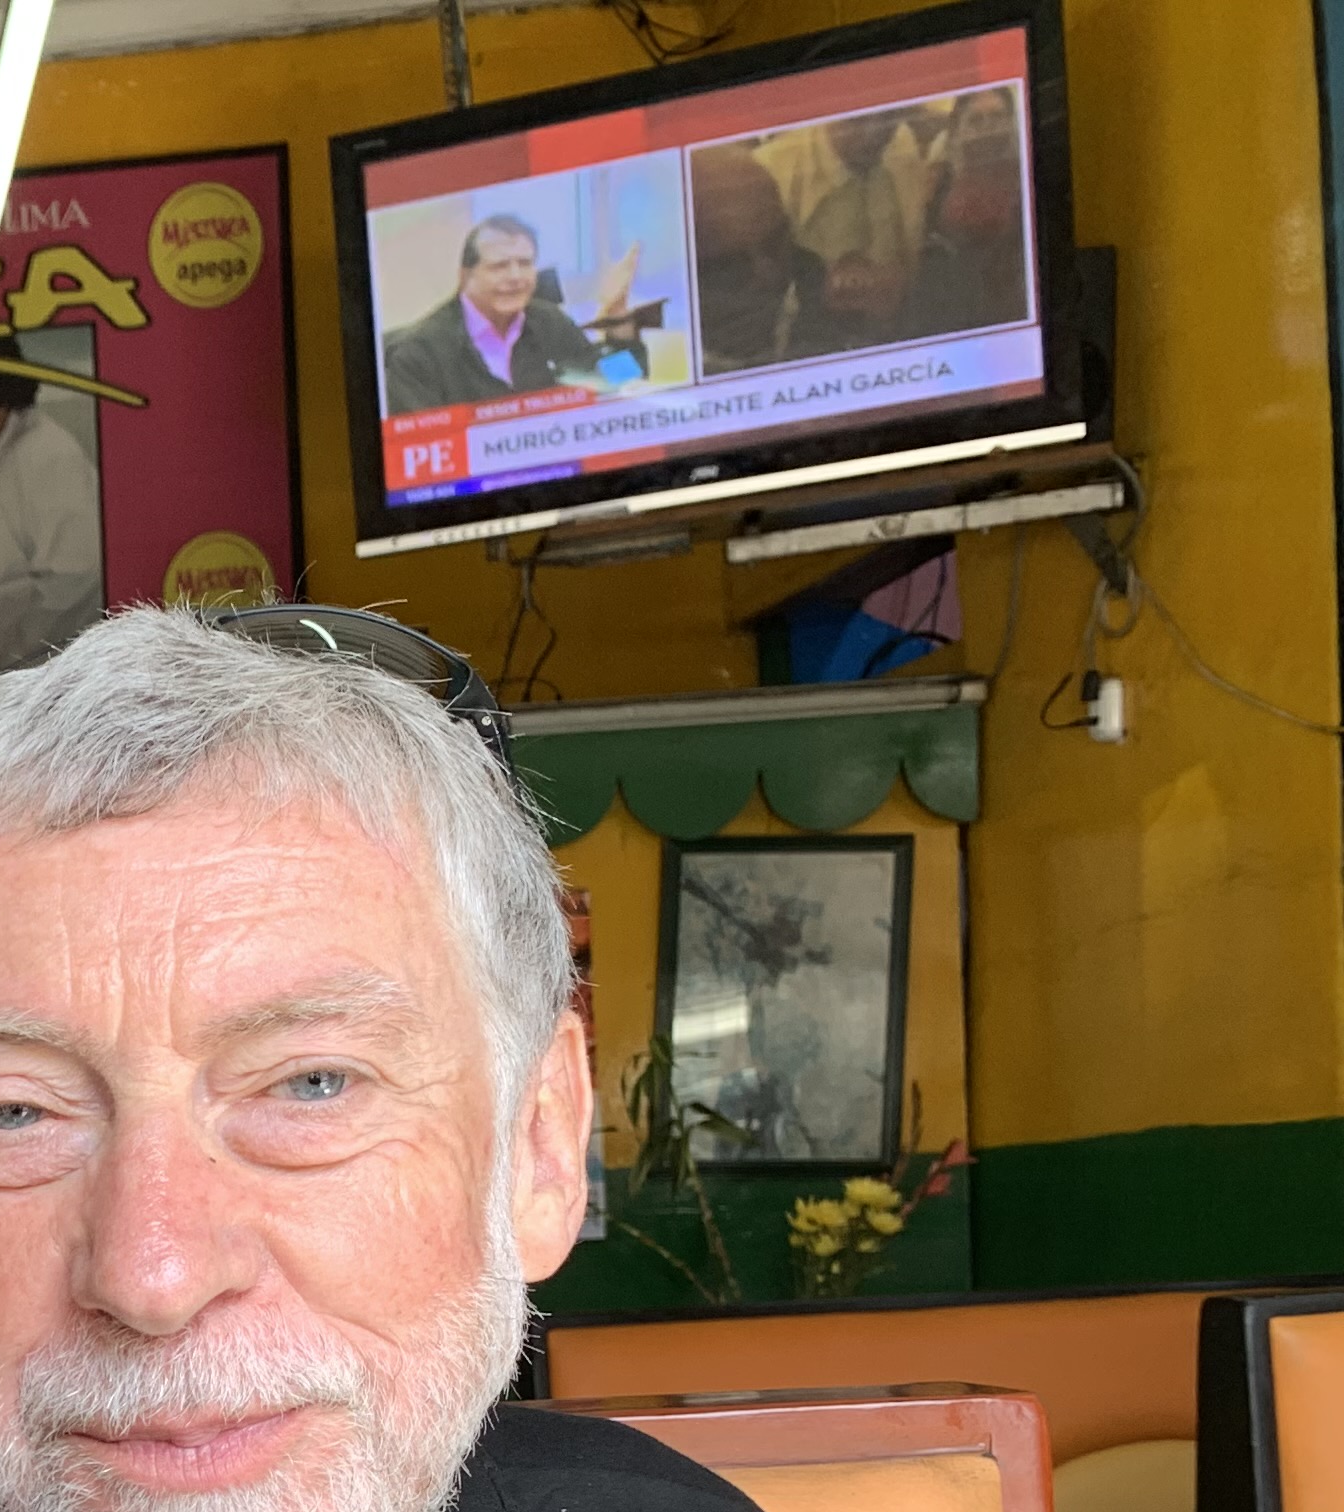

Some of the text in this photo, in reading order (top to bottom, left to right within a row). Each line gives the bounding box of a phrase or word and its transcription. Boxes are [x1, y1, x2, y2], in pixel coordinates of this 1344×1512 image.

[484, 357, 955, 459] MURIÓ EXPRESIDENTE ALAN GARCÍA
[403, 439, 456, 479] PE
